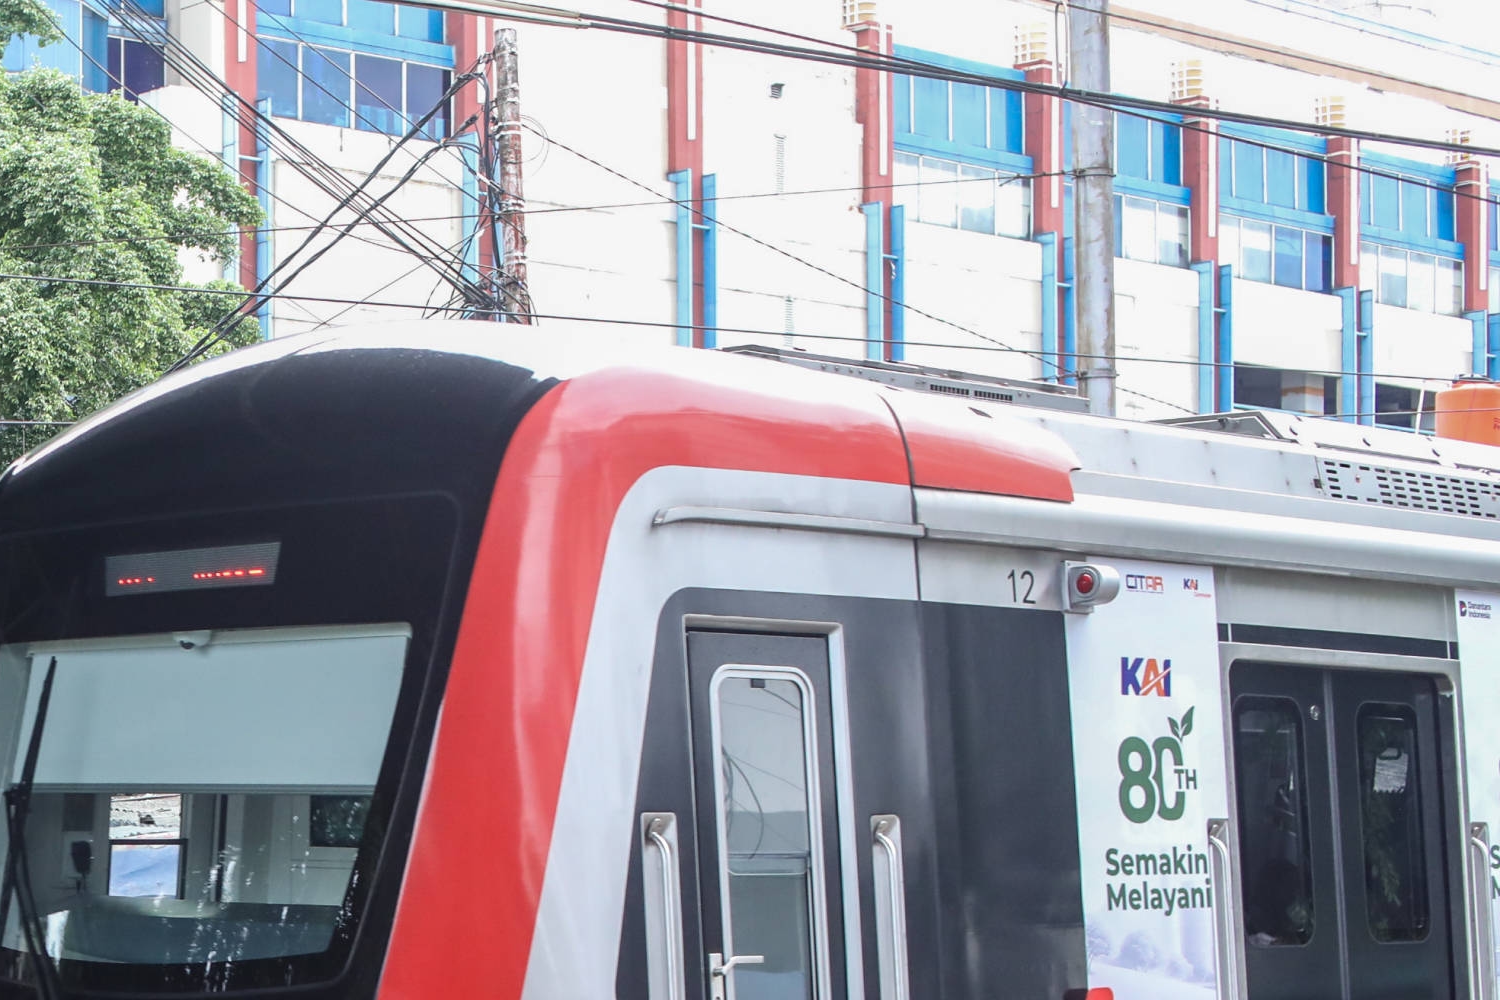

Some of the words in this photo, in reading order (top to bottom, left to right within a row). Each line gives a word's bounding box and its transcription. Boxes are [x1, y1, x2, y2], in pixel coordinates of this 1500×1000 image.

[1008, 569, 1036, 604] 12
[1183, 578, 1198, 590] KAI
[1120, 656, 1172, 697] KAI
[1105, 845, 1208, 877] Semakin
[1106, 880, 1212, 917] Melayani
